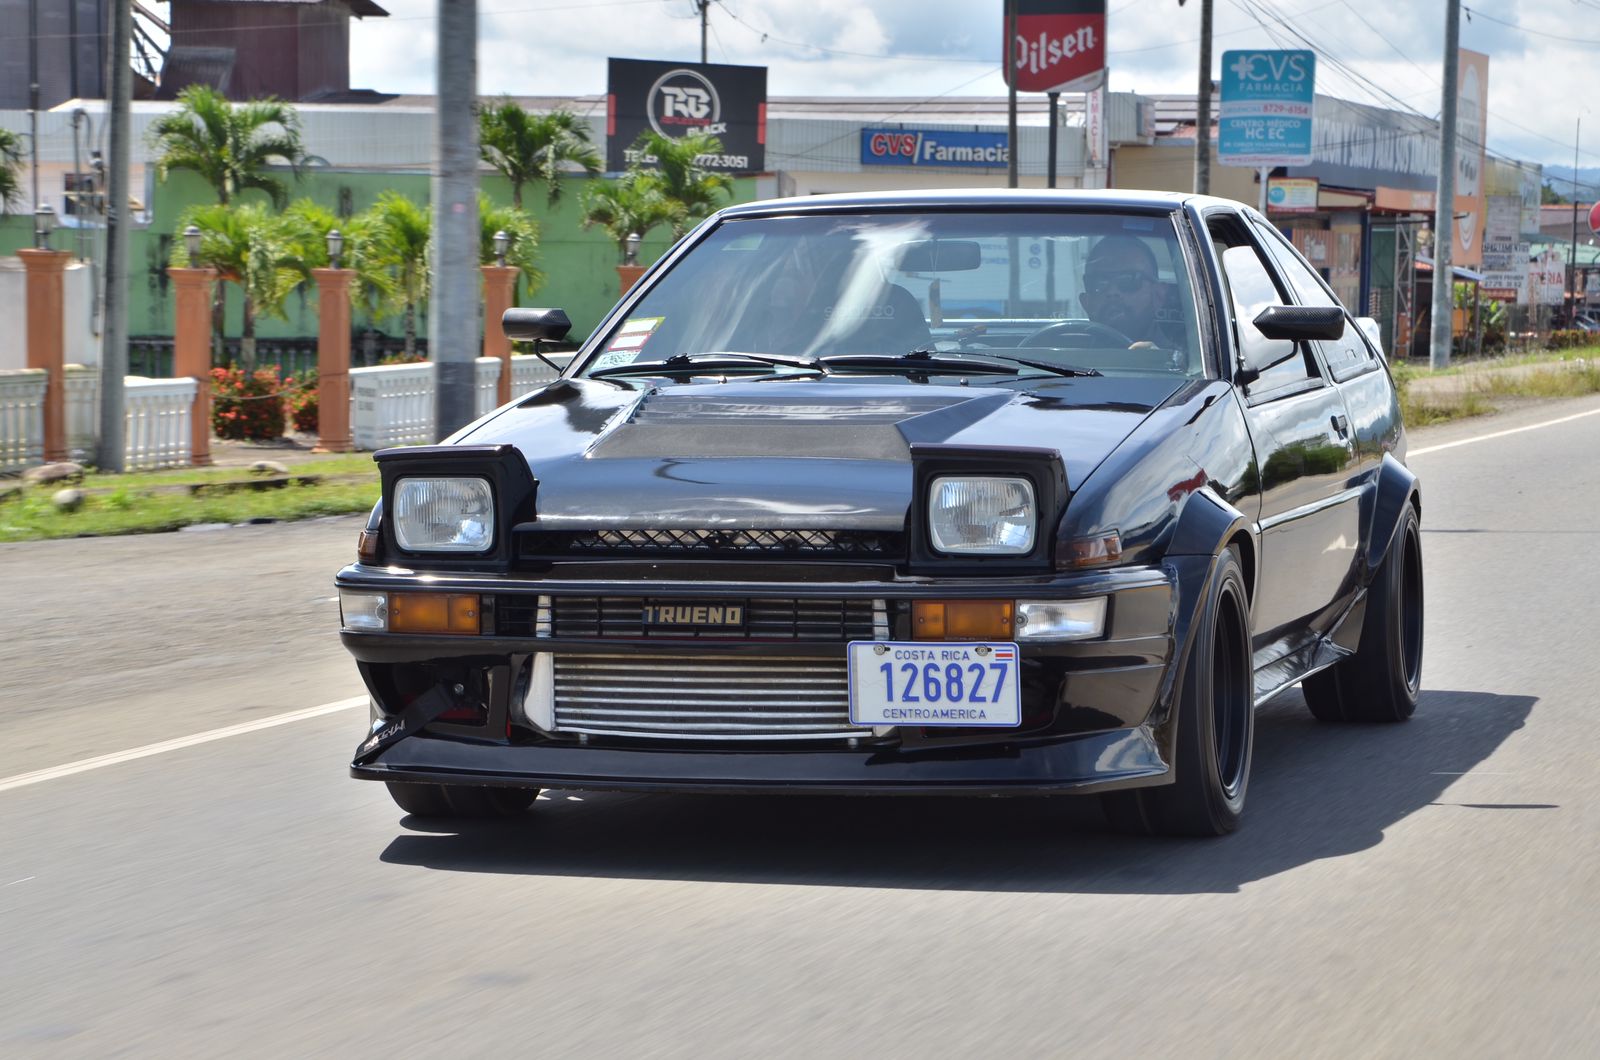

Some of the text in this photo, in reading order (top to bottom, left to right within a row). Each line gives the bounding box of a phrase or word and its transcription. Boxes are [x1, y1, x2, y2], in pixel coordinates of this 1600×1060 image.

[1249, 54, 1306, 82] CVS
[1239, 83, 1304, 92] FARMACIA
[1231, 119, 1265, 128] CENTRO
[1245, 128, 1286, 140] HC EC
[644, 606, 742, 625] TRUENO
[895, 650, 970, 661] COSTA RICA
[880, 662, 1009, 703] 126827
[882, 708, 987, 720] CENTROAMERICA
